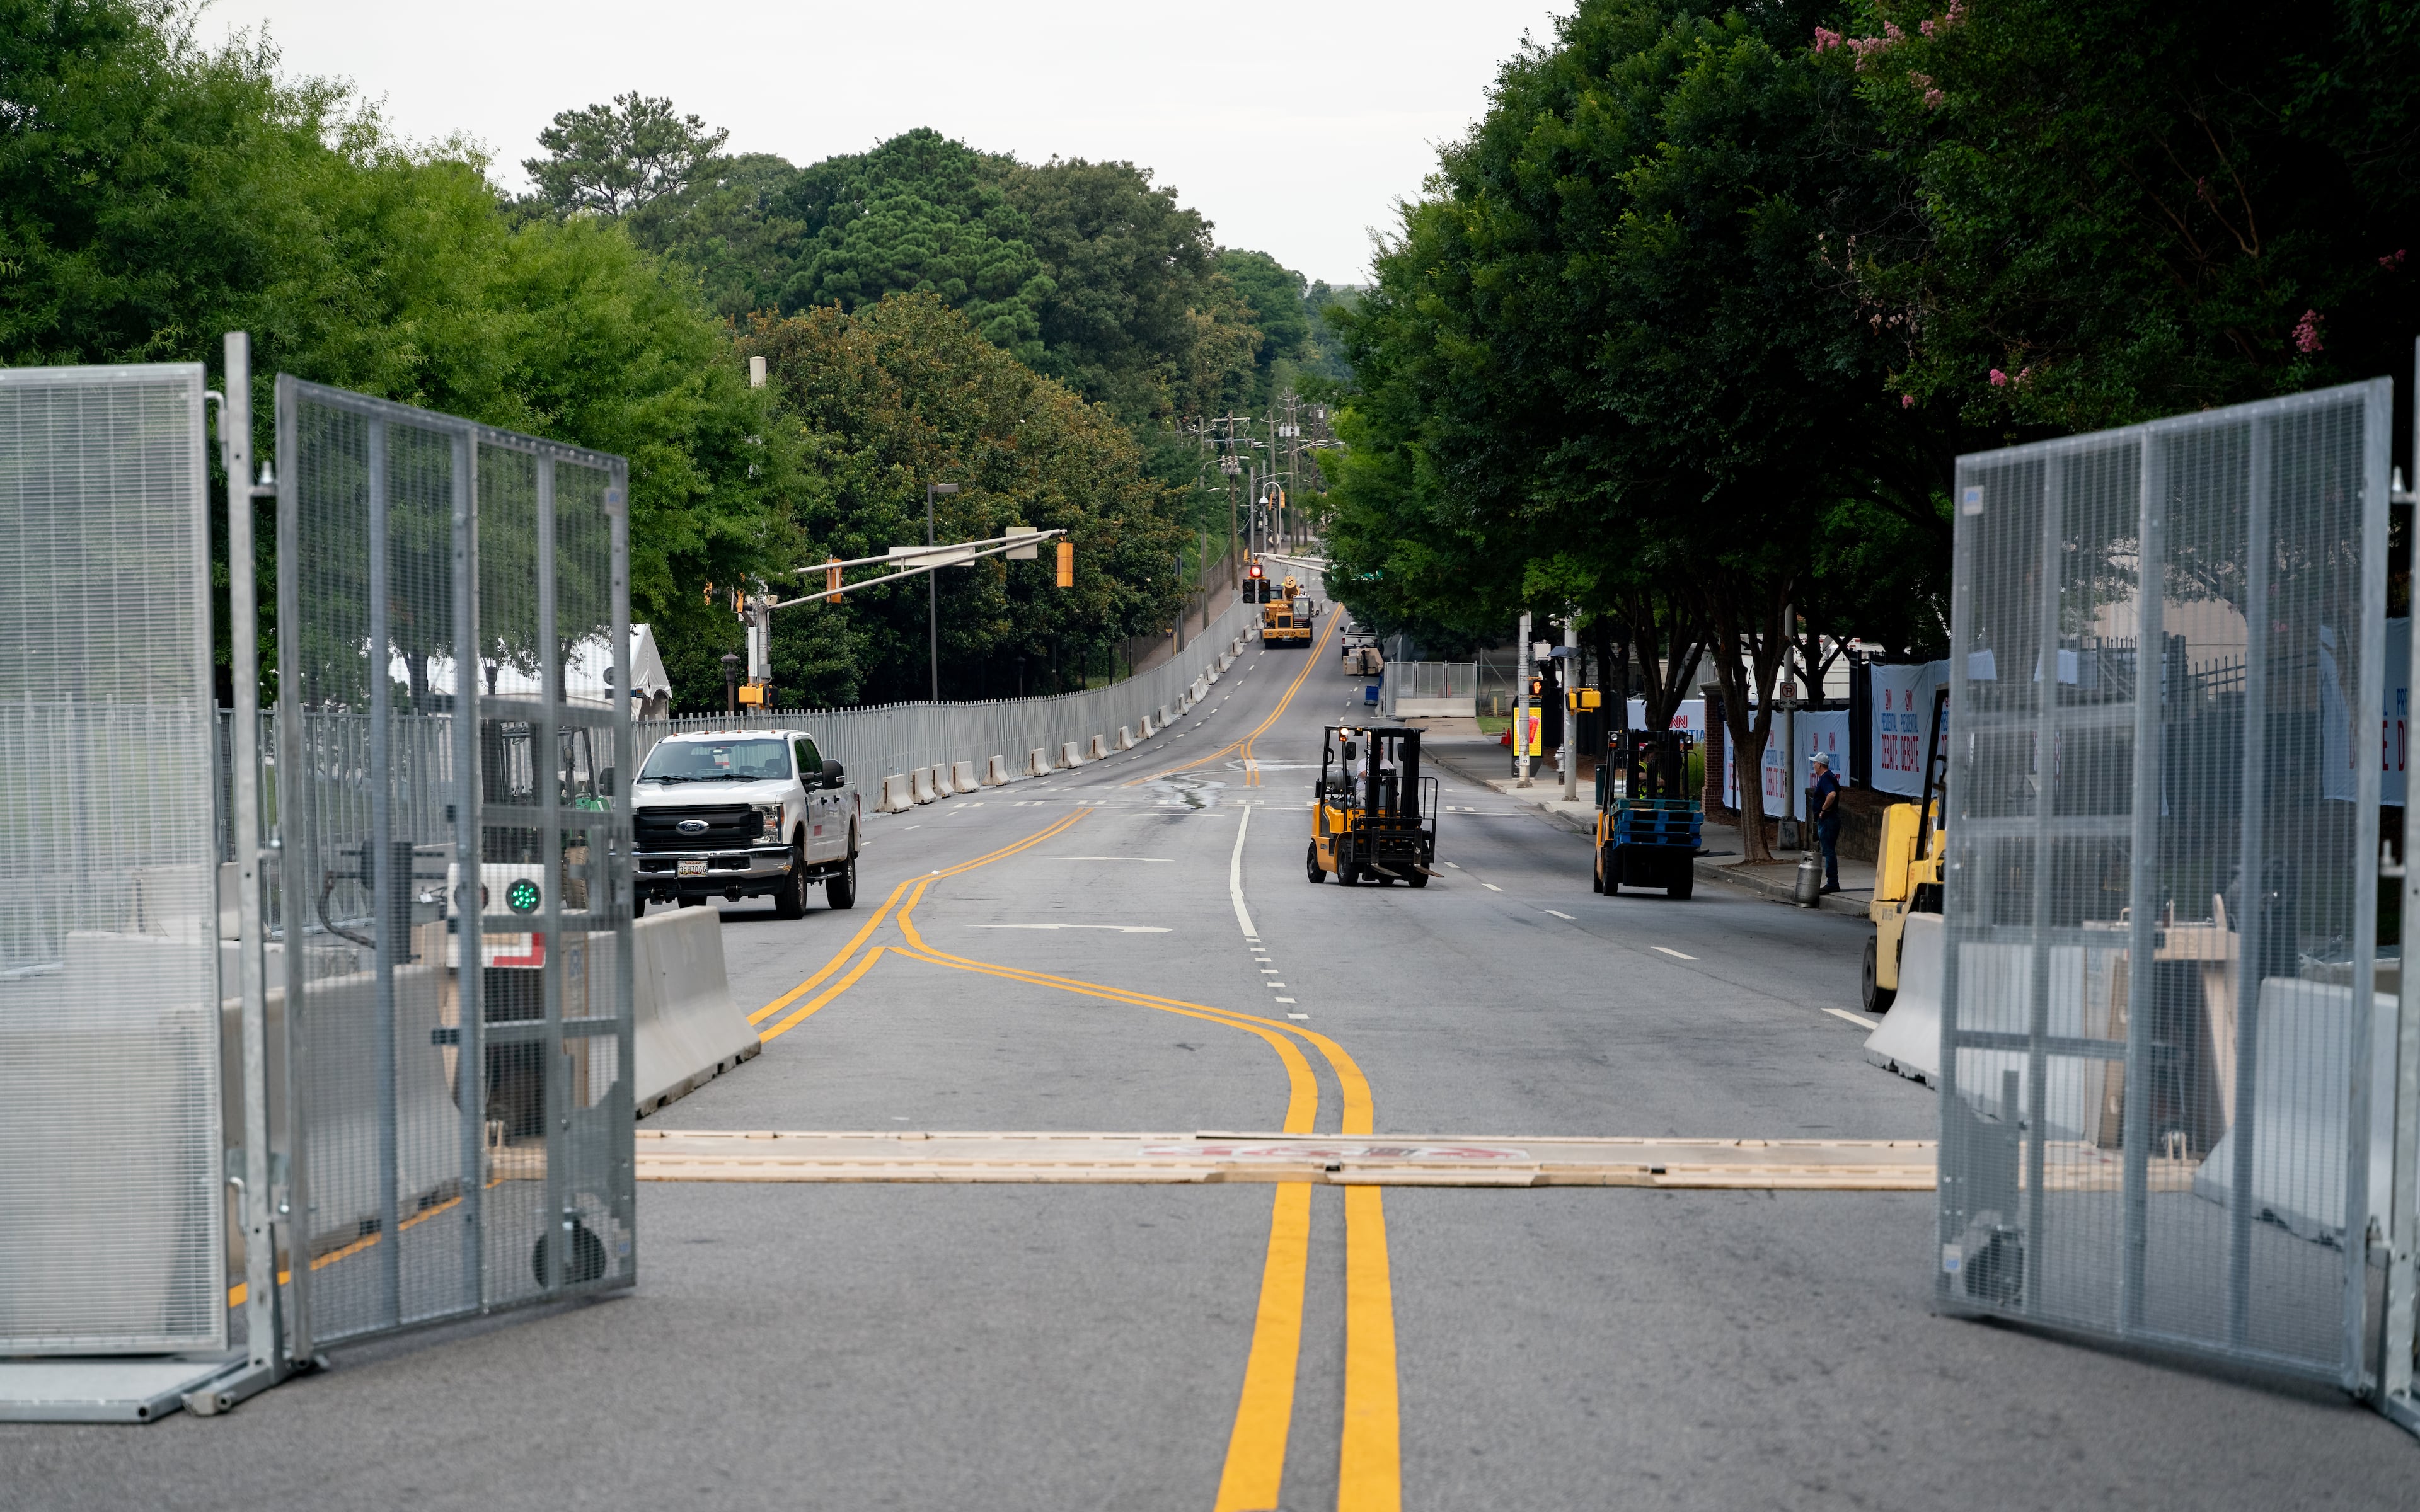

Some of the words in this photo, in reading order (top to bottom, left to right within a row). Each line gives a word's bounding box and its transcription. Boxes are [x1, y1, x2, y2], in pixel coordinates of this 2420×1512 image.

[1882, 735, 1898, 770] DEBATE
[1901, 735, 1919, 772] DEBATE
[1766, 767, 1778, 797] DEBATE
